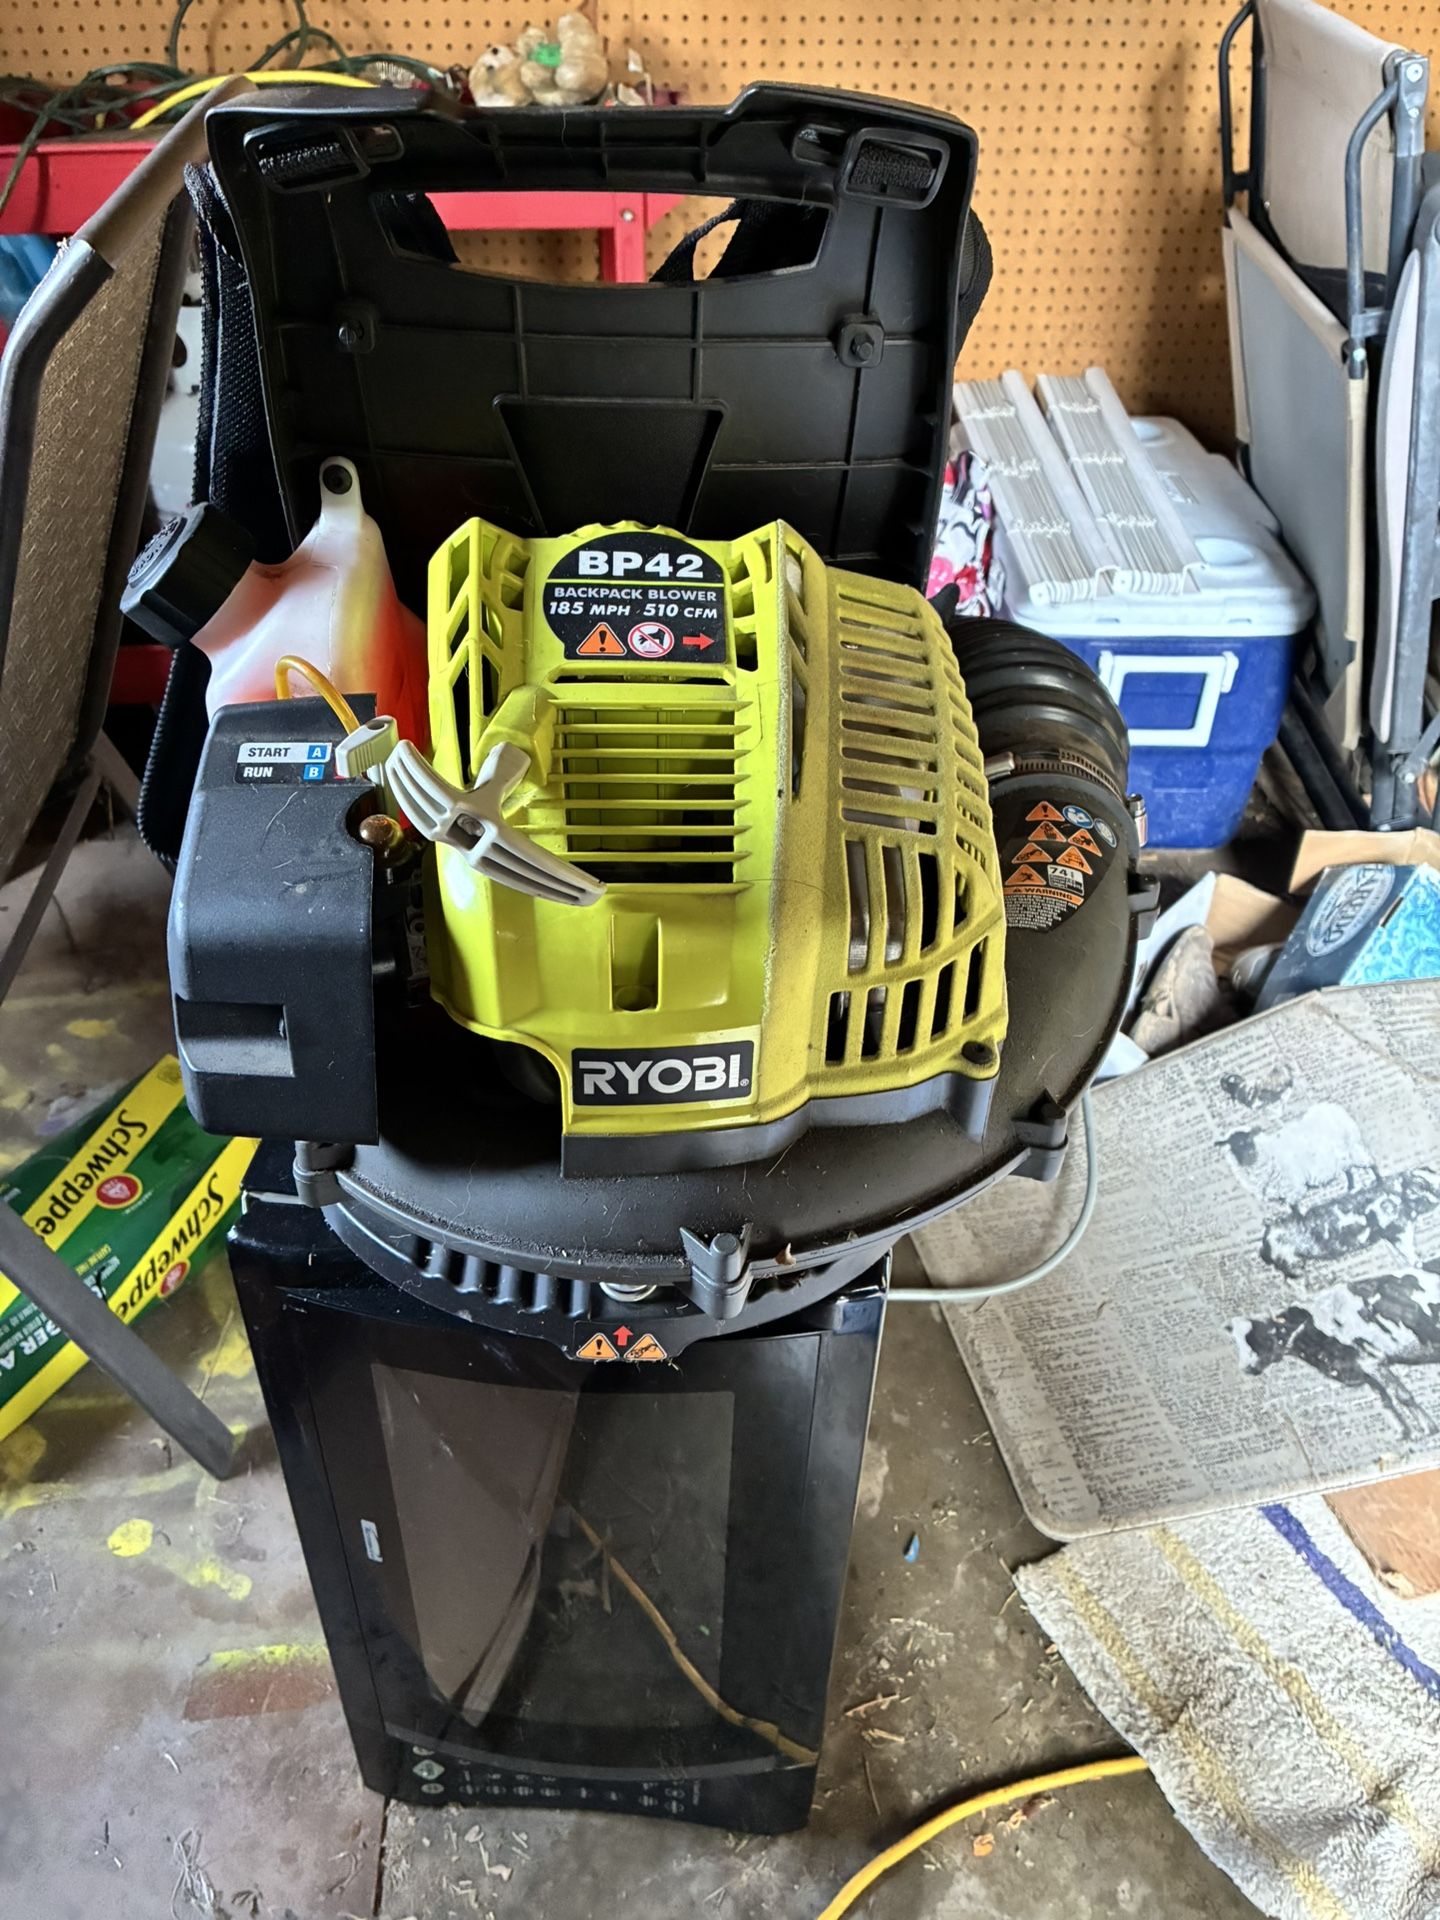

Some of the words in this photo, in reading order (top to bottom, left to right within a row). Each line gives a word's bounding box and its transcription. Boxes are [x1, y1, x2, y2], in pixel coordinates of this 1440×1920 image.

[578, 550, 704, 579] BP42
[554, 587, 643, 600] BACKPACK
[648, 589, 717, 601] BLOWER
[549, 601, 584, 615] 185
[589, 604, 631, 616] MPH
[643, 603, 679, 617] 510
[683, 607, 718, 619] CFM
[247, 747, 291, 758] START
[311, 747, 322, 758] A
[243, 766, 274, 778] RUN
[308, 767, 319, 777] B
[1024, 887, 1073, 901] WARNING
[579, 1053, 741, 1096] RYOBI
[35, 1109, 148, 1240] Schweppe
[116, 1172, 224, 1317] Schweppe
